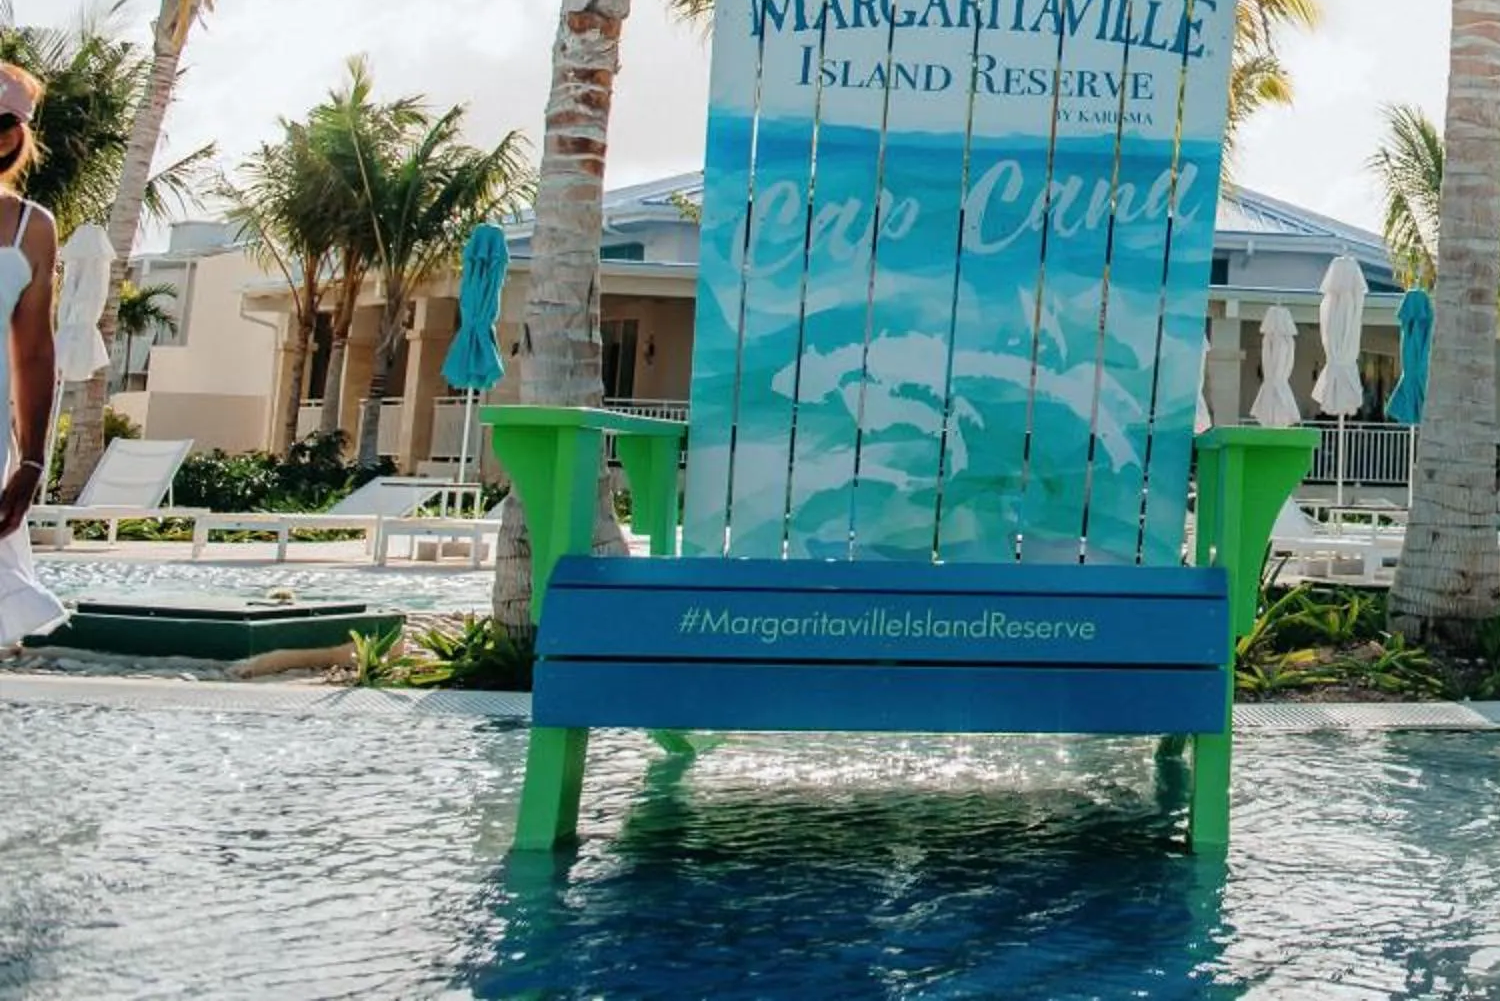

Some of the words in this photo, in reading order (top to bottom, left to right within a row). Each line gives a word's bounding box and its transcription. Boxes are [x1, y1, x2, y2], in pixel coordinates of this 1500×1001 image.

[795, 45, 951, 91] ISLAND
[968, 54, 1153, 99] RESERVE
[731, 180, 920, 286] Cap
[679, 607, 1096, 643] #MargaritavilleIslandReserve
